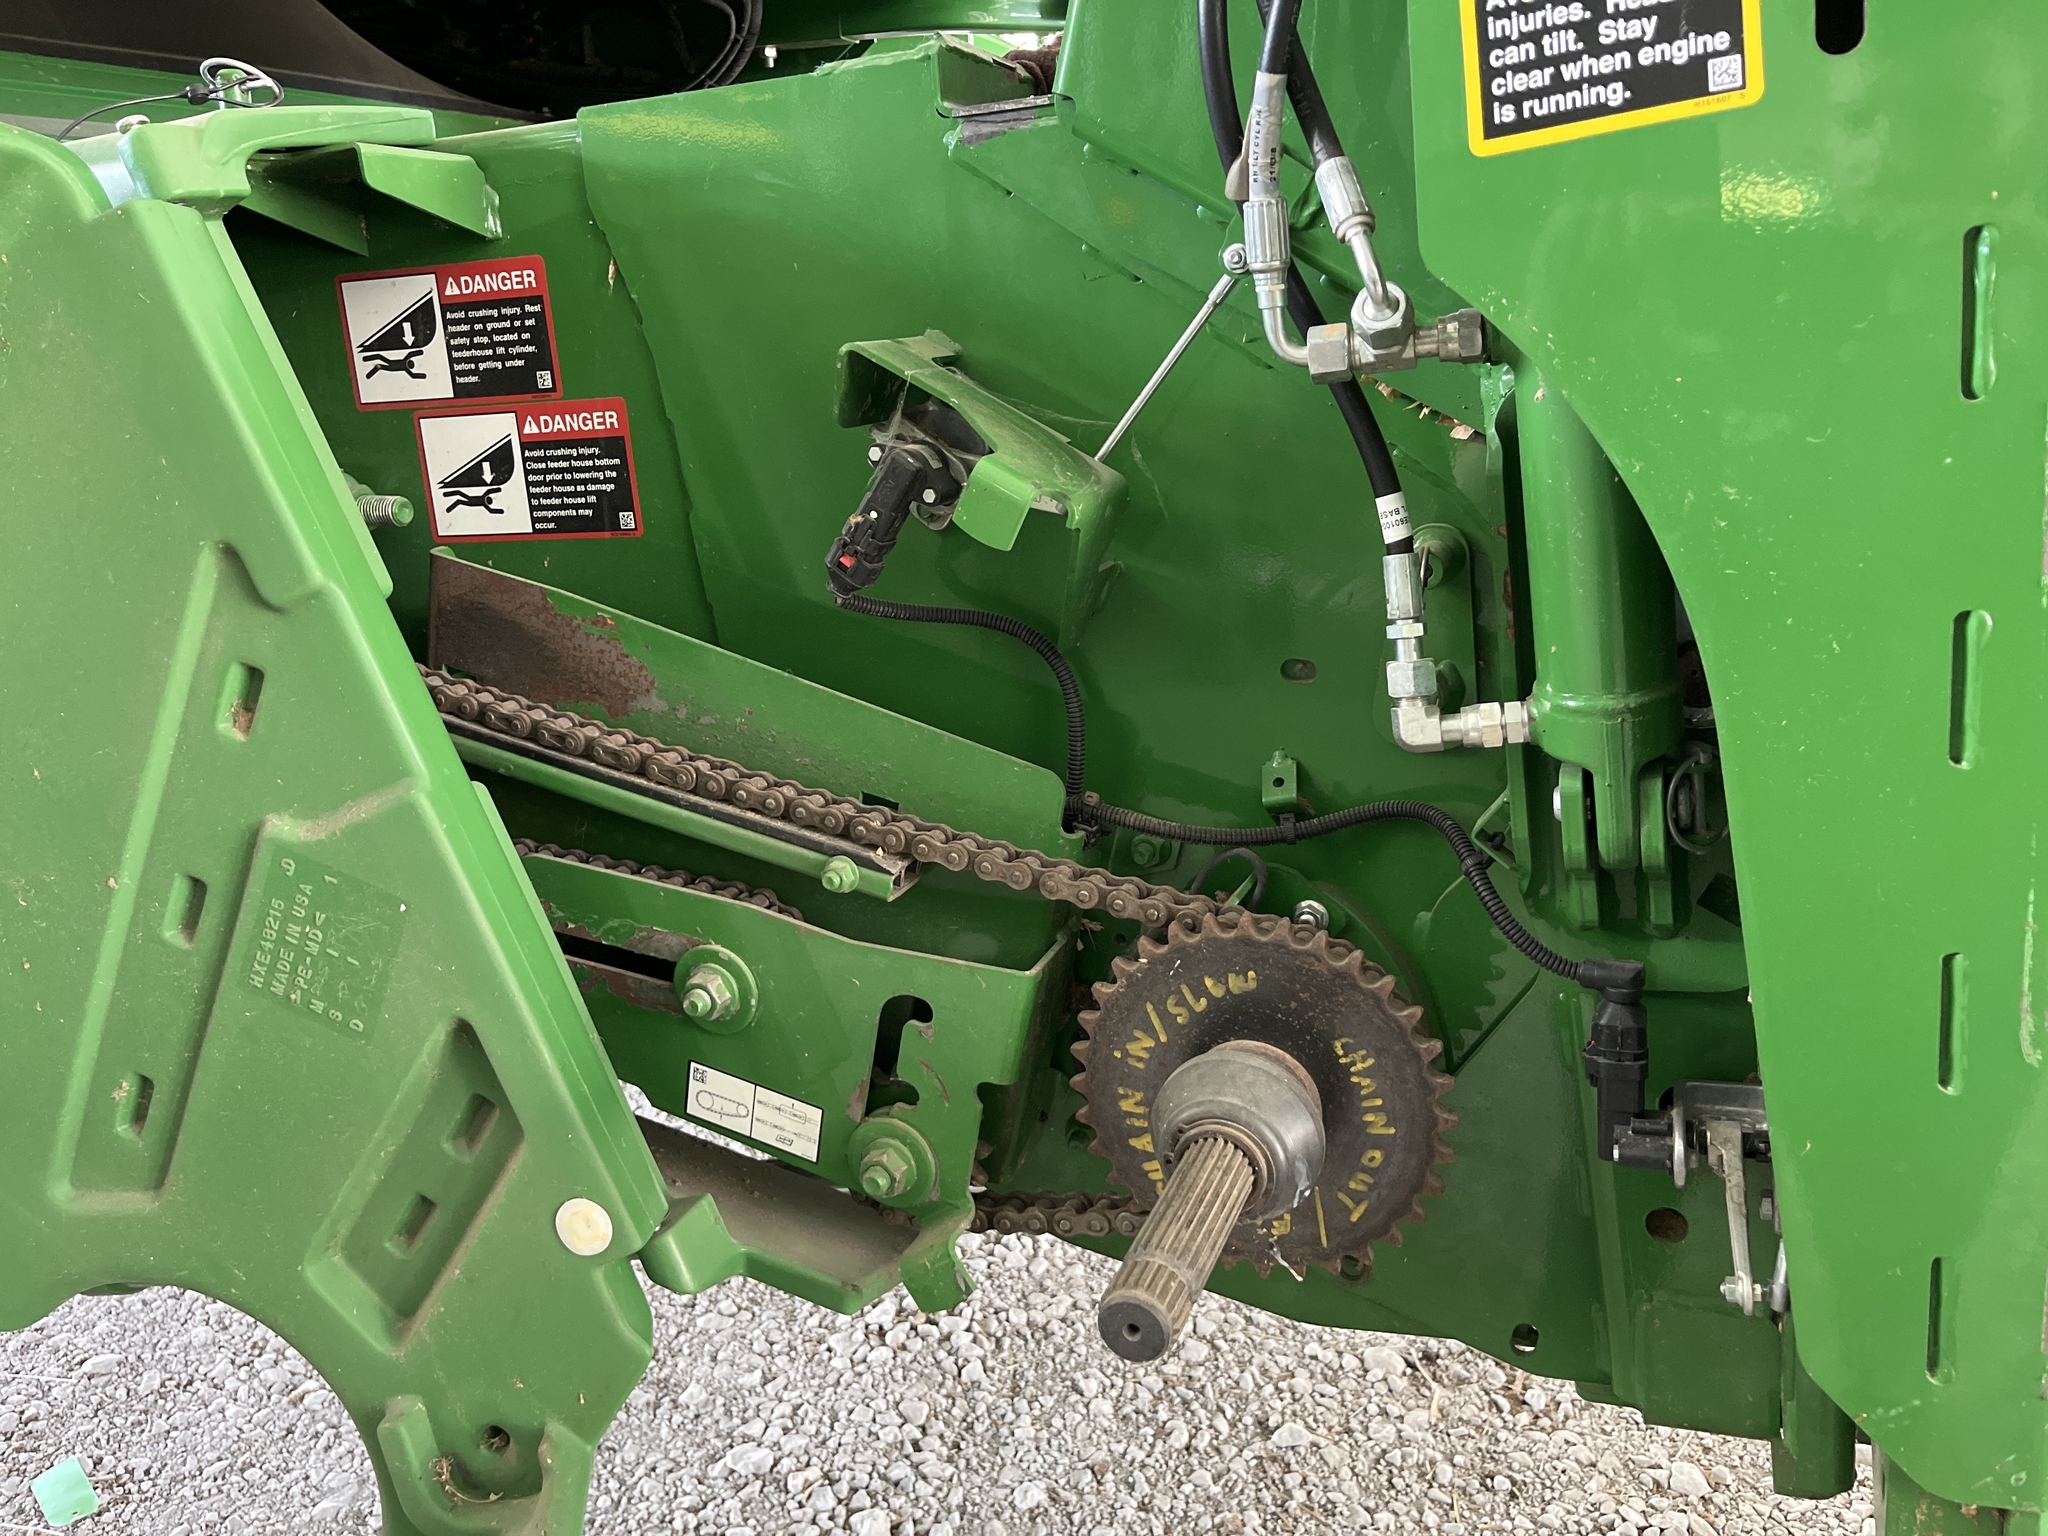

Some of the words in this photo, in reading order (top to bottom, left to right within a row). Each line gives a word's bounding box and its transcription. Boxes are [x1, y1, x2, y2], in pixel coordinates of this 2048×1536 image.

[1487, 2, 1592, 40] injuries.
[1489, 41, 1535, 68] can
[1542, 29, 1584, 56] tilt.
[1598, 16, 1658, 44] Stay
[1491, 66, 1554, 96] clear
[1560, 51, 1631, 82] when
[1638, 31, 1730, 66] engine
[1492, 102, 1516, 124] is
[1522, 81, 1632, 119] running.
[460, 270, 537, 294] DANGER
[446, 311, 465, 319] Avoid
[468, 308, 498, 317] crushing
[501, 306, 522, 316] injury.
[525, 304, 540, 312] Rest
[448, 324, 470, 332] header
[486, 320, 510, 331] ground
[525, 318, 535, 326] set
[450, 337, 470, 346] safety
[473, 335, 490, 344] stop,
[493, 333, 518, 341] located
[452, 348, 493, 358] feederhouse
[508, 345, 537, 355] cylinder,
[454, 362, 475, 371] before
[478, 360, 502, 371] getting
[505, 359, 525, 367] under
[456, 375, 480, 383] header.
[540, 411, 618, 433] DANGER
[525, 449, 544, 457] Avoid
[546, 447, 577, 456] crushing
[578, 446, 600, 455] injury.
[526, 461, 546, 470] Close
[548, 460, 569, 468] feeder
[528, 474, 544, 482] door
[546, 472, 562, 482] prior
[573, 470, 603, 480] lowering
[553, 484, 575, 492] house
[587, 483, 614, 492] damage
[540, 497, 562, 505] feeder
[564, 496, 585, 504] house
[587, 495, 597, 503] lift
[533, 509, 576, 518] components
[578, 509, 593, 517] may
[292, 884, 312, 918] USA
[285, 923, 301, 945] IN
[249, 898, 284, 988] HXE48215
[270, 948, 294, 996] MADE
[309, 998, 324, 1014] M
[329, 1009, 342, 1021] S
[350, 1019, 364, 1032] D
